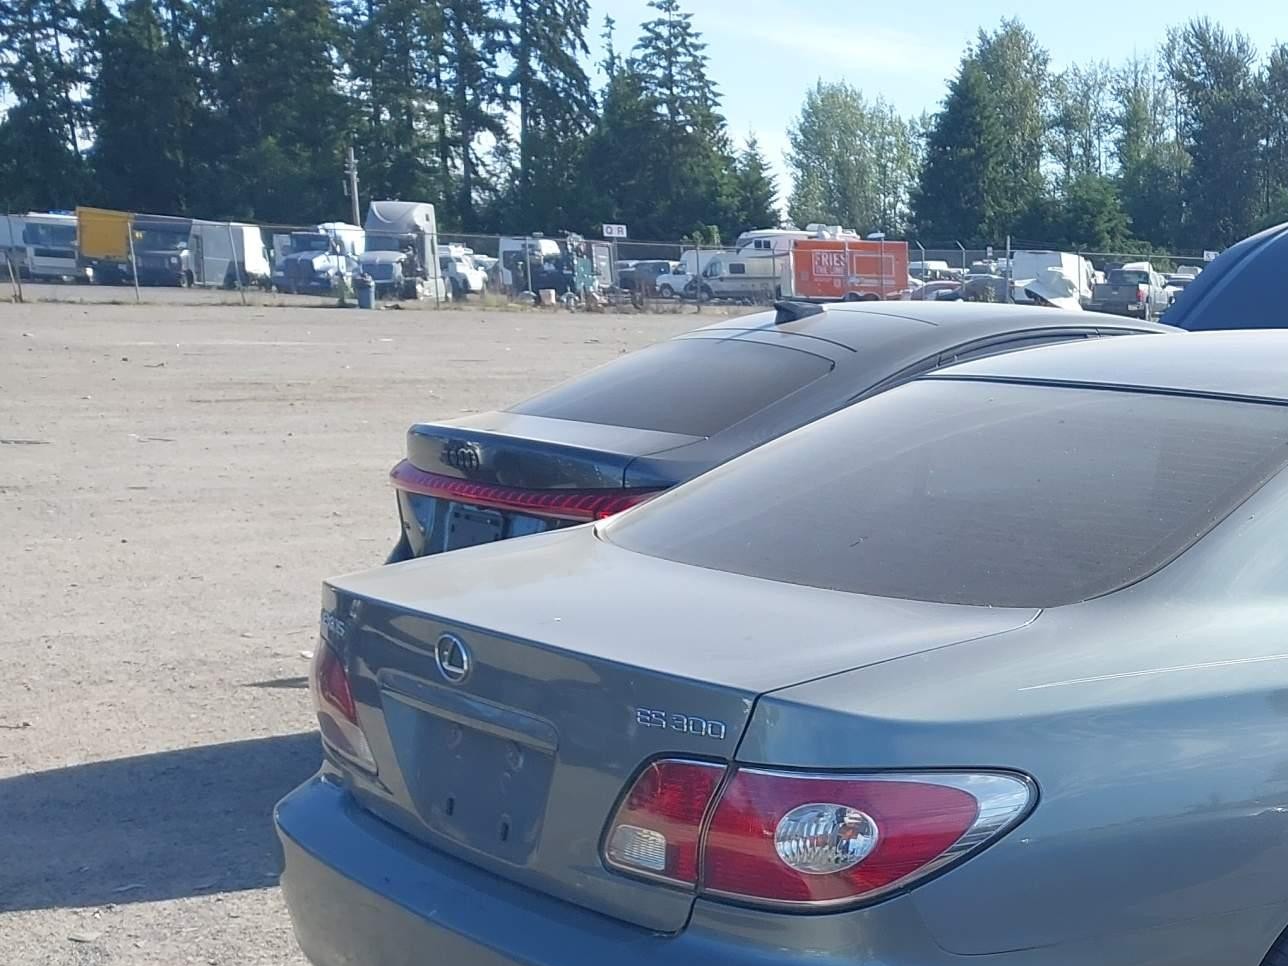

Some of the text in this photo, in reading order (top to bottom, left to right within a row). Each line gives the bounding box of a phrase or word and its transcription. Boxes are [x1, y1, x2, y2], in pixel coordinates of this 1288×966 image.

[815, 252, 846, 266] FRIES
[636, 707, 726, 740] ES 300
